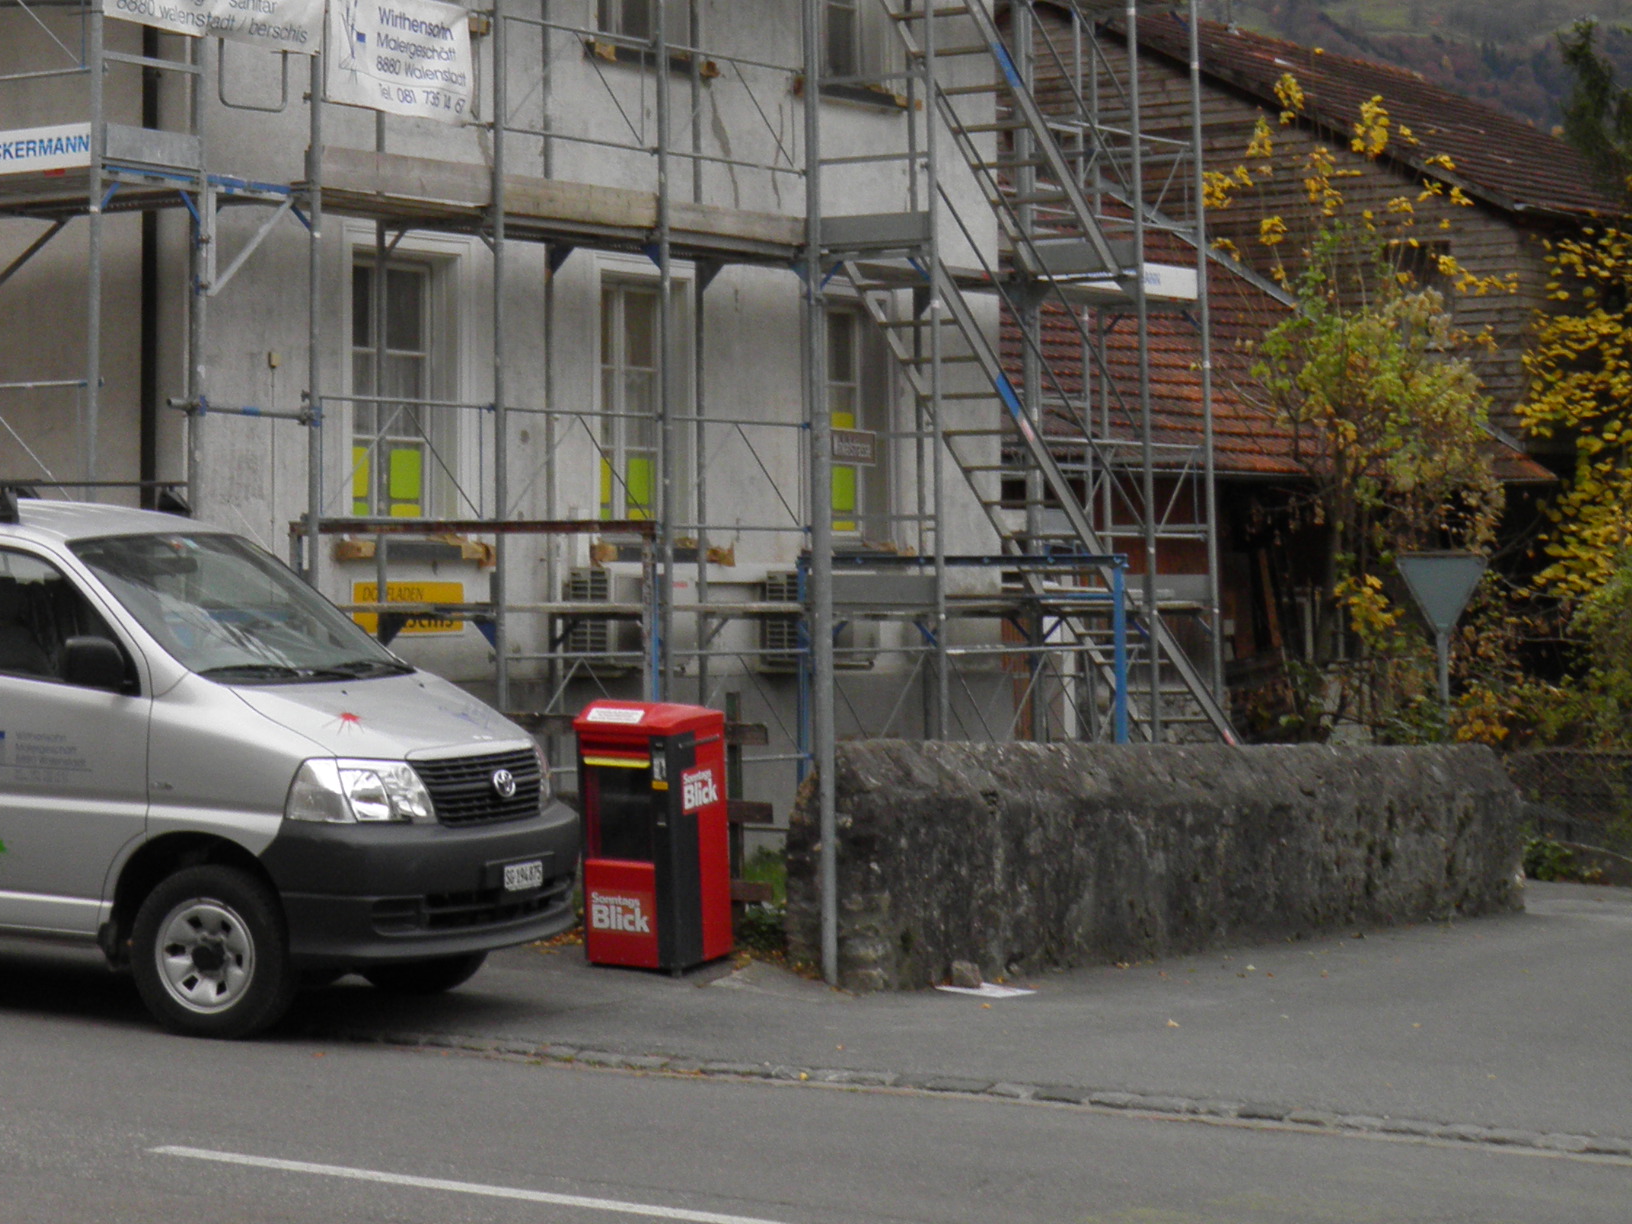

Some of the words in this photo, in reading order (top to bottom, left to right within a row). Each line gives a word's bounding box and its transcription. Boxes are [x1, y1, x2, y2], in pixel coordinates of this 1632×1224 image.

[159, 4, 236, 31] walenstadt
[249, 18, 308, 45] berschis
[378, 6, 454, 41] Wirthensohn
[376, 32, 456, 61] Malergeschäft
[376, 56, 401, 75] 8880
[404, 61, 466, 87] Walenstadt
[397, 87, 416, 104] 081
[684, 778, 718, 810] Blick
[591, 891, 641, 908] Sonntags
[592, 904, 650, 933] Blick
